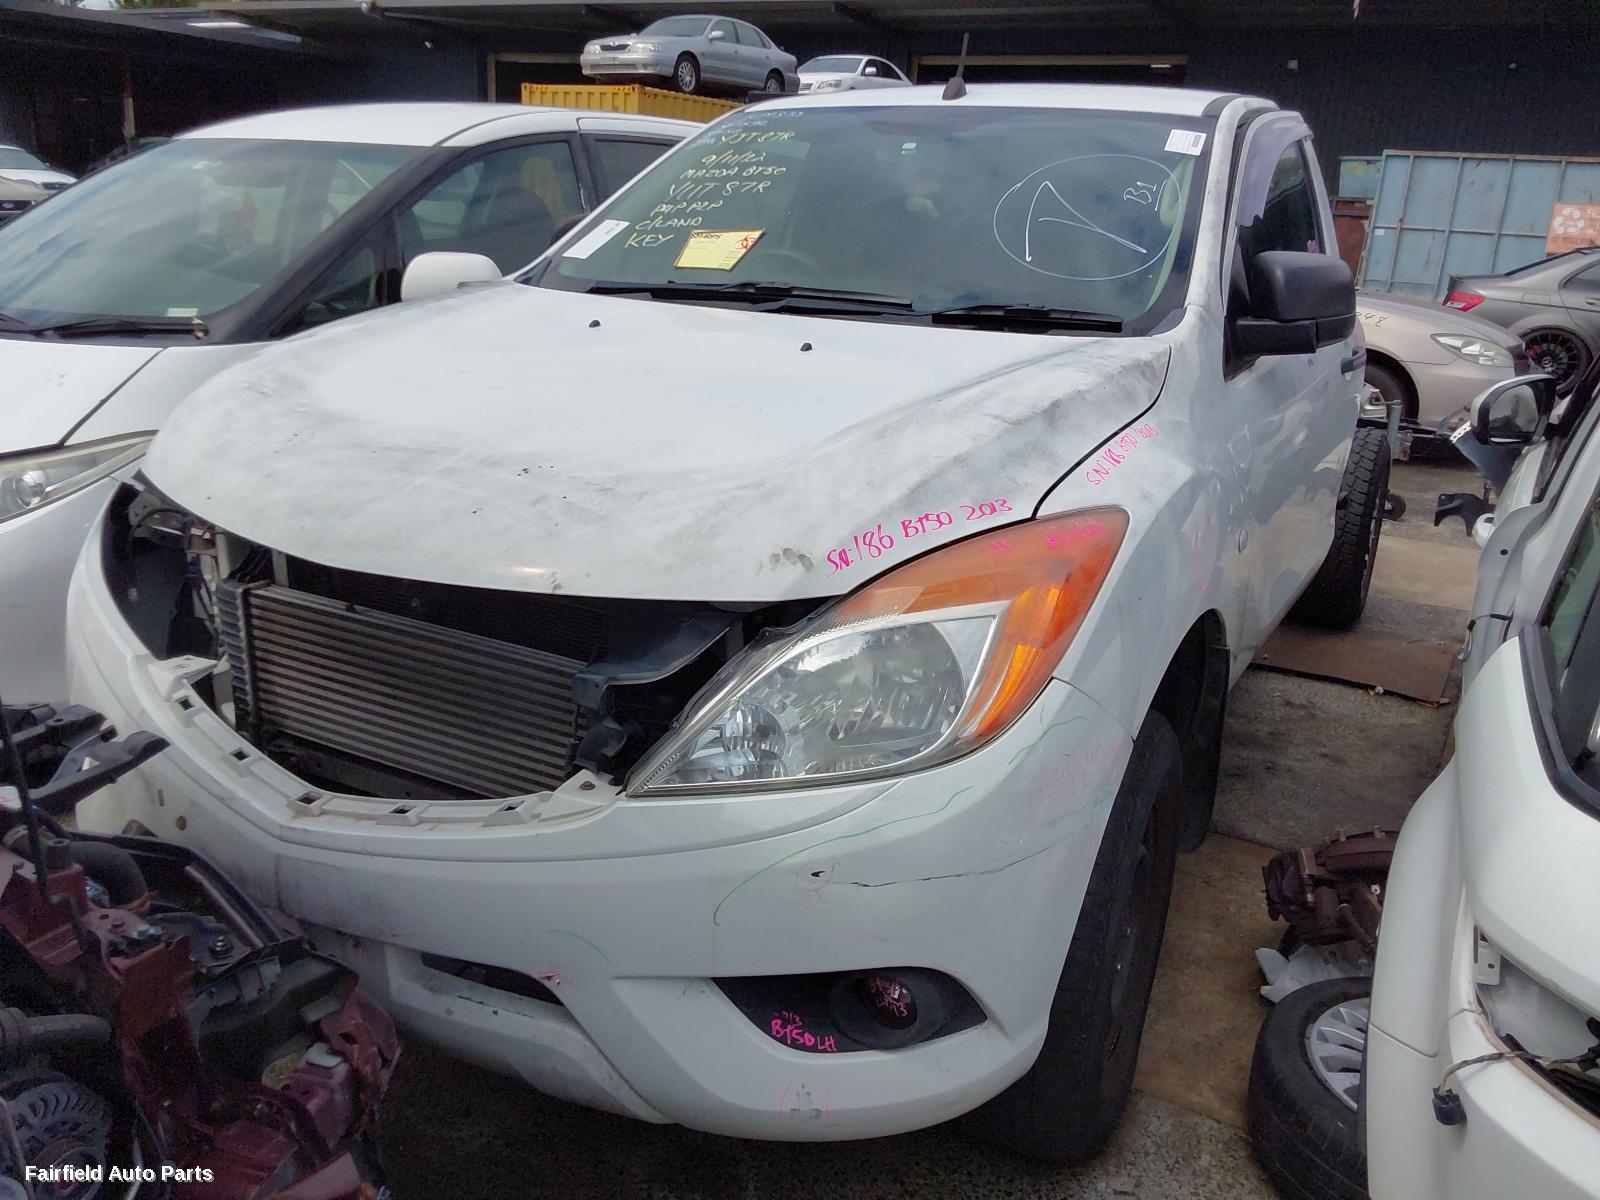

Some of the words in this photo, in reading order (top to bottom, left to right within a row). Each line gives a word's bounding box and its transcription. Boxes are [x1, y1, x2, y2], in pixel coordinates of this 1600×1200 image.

[624, 232, 675, 249] KEY
[900, 511, 953, 538] BT50
[959, 498, 1013, 521] 2013
